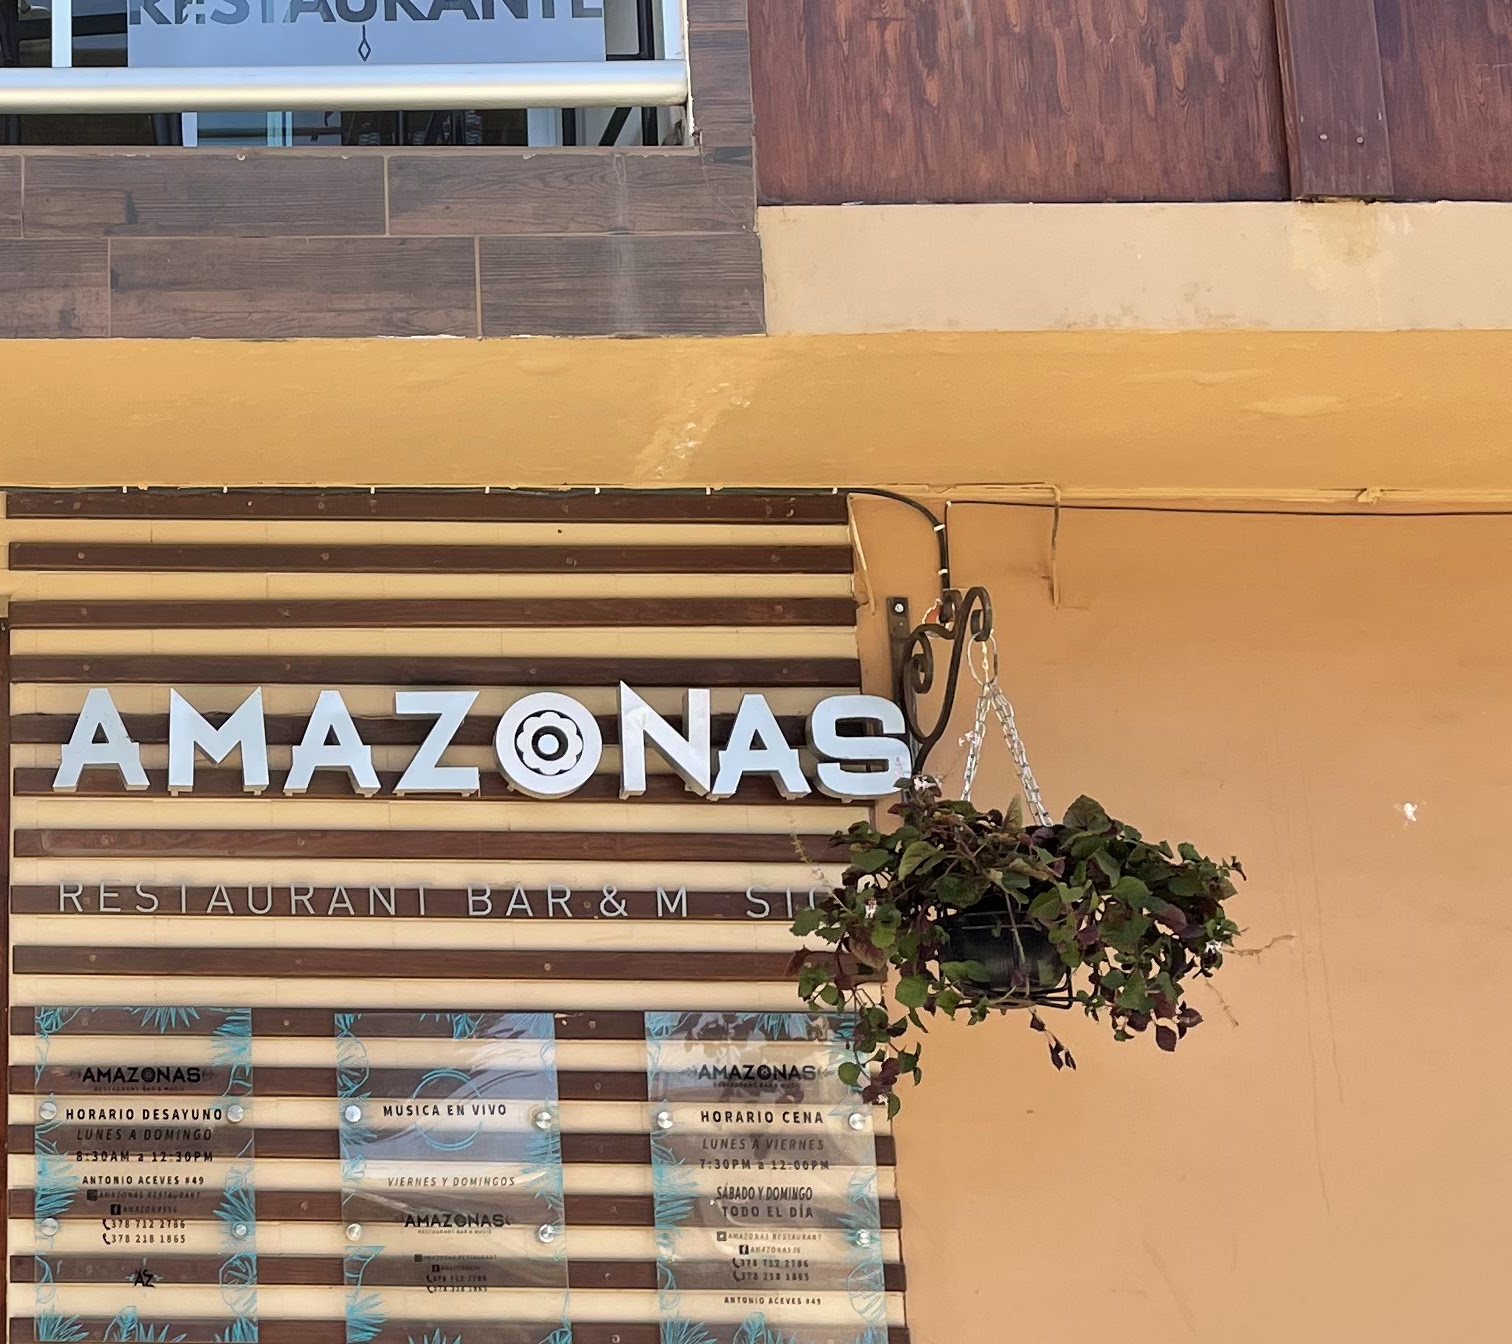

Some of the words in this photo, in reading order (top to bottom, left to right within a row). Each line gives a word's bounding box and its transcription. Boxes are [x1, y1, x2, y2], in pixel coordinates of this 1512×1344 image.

[52, 679, 913, 802] AMAZONAS
[58, 880, 430, 917] RESTAURANT
[467, 884, 573, 918] BAR
[599, 884, 628, 919] &
[82, 1066, 201, 1083] AMAZONAS
[697, 1064, 817, 1081] AMAZONAS
[65, 1108, 135, 1120] HORARIO
[142, 1109, 223, 1121] DESAYUNO
[383, 1104, 440, 1116] MUSICA
[447, 1105, 465, 1116] EN
[471, 1104, 507, 1116] VIVO
[701, 1110, 774, 1123] HORARIO
[782, 1111, 823, 1123] CENA
[76, 1128, 122, 1141] LUNES
[128, 1129, 137, 1141] A
[144, 1129, 212, 1141] DOMINGO
[702, 1138, 745, 1150] LUNES
[751, 1138, 760, 1150] A
[767, 1138, 824, 1150] VIERNES
[76, 1150, 130, 1162] 8:30AM
[151, 1151, 214, 1163] 12:30PM
[698, 1159, 751, 1170] 7:30PM
[771, 1159, 830, 1171] 12:00PM
[82, 1175, 133, 1185] ANTONIO
[137, 1175, 180, 1185] ACEVES
[185, 1175, 205, 1185] #49
[387, 1176, 437, 1187] VIERNES
[441, 1177, 448, 1187] Y
[452, 1177, 515, 1187] DOMINGOS
[716, 1183, 755, 1200] SÁBADO
[758, 1186, 764, 1200] Y
[766, 1186, 813, 1200] DOMINGO
[721, 1206, 760, 1218] TODO
[767, 1206, 783, 1218] EL
[789, 1205, 814, 1218] DÍA
[111, 1219, 130, 1229] 378
[404, 1213, 504, 1228] AMAZONAS
[111, 1234, 130, 1244] 378
[135, 1234, 155, 1244] 218
[160, 1234, 186, 1244] 1865
[724, 1296, 765, 1305] ANTONIO
[768, 1296, 802, 1305] ACEVES
